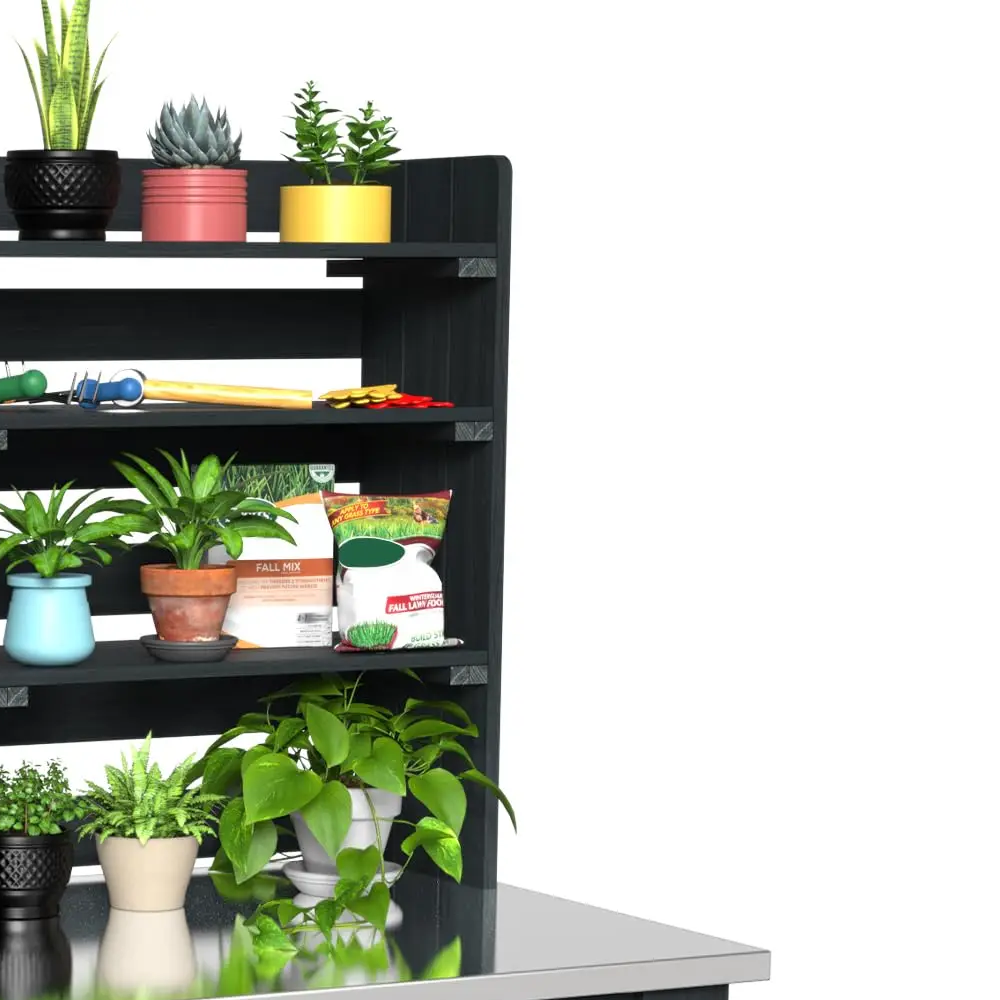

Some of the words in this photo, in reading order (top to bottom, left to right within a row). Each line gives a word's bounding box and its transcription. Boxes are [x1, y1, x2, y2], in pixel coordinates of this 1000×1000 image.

[341, 504, 359, 515] APPLY
[360, 501, 369, 510] TO
[344, 509, 364, 520] GRASS
[364, 507, 380, 516] TYPE
[256, 563, 281, 573] FALL
[282, 562, 301, 572] MIX
[388, 603, 407, 613] FALL
[408, 600, 426, 611] LAWN
[426, 598, 443, 608] FOO
